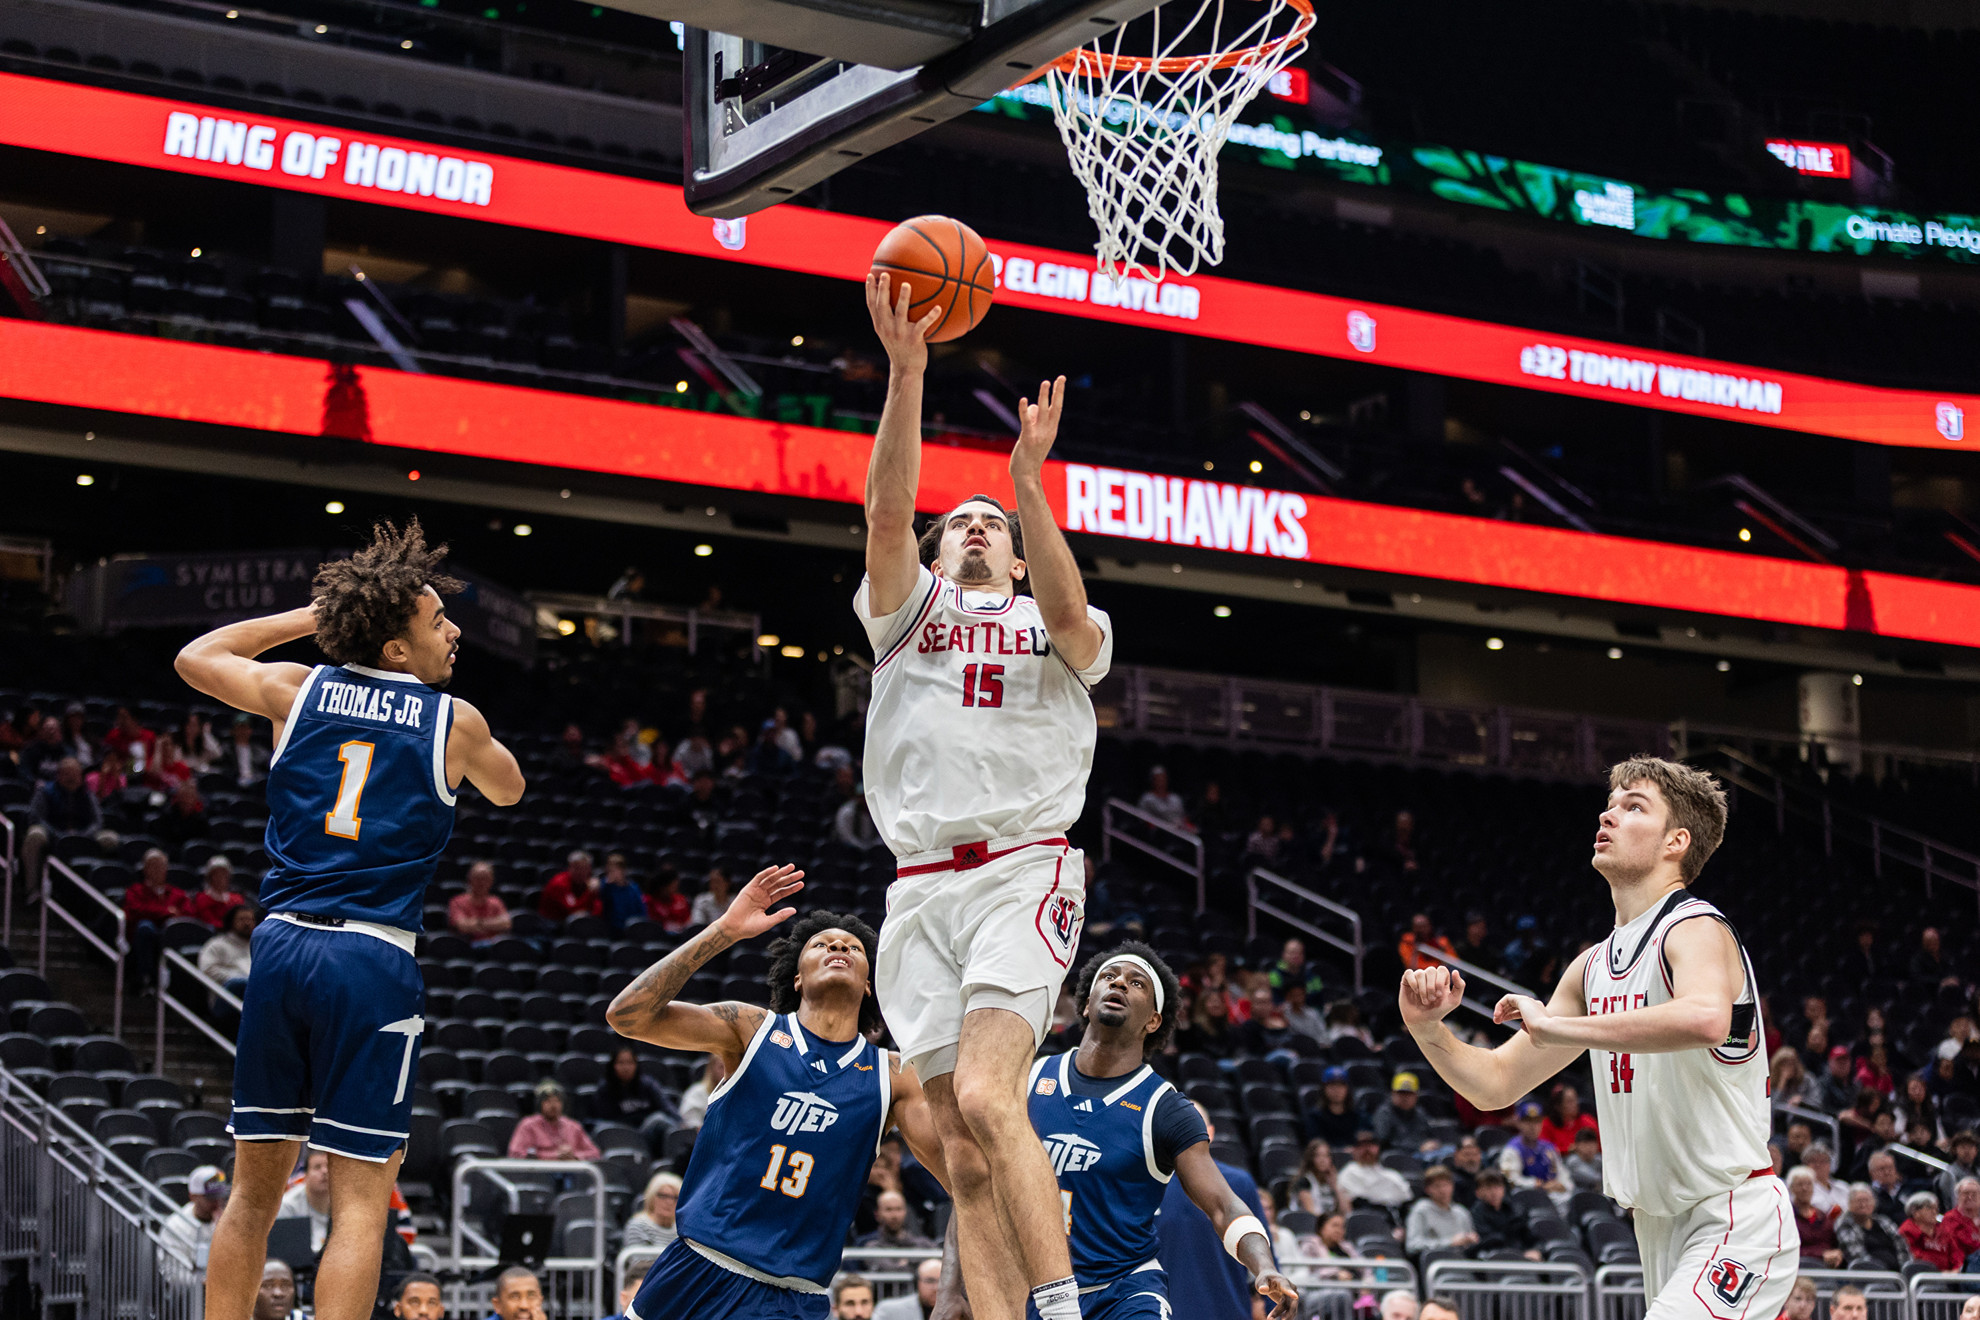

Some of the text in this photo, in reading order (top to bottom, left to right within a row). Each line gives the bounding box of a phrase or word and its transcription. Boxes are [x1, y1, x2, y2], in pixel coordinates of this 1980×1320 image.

[163, 111, 494, 206] RING OF HONOR
[1302, 130, 1384, 168] Partner
[1846, 214, 1923, 245] Climate
[1004, 257, 1089, 301] ELGIN
[1090, 270, 1201, 320] BAYLOR
[1568, 349, 1657, 393] TOMMY
[1657, 364, 1783, 414] WORKMAN
[1066, 463, 1309, 559] REDHAWKS
[317, 681, 424, 728] THOMAS JR
[962, 663, 1005, 708] 15
[325, 740, 376, 841] 1
[770, 1091, 839, 1135] UTEP
[760, 1143, 815, 1199] 13
